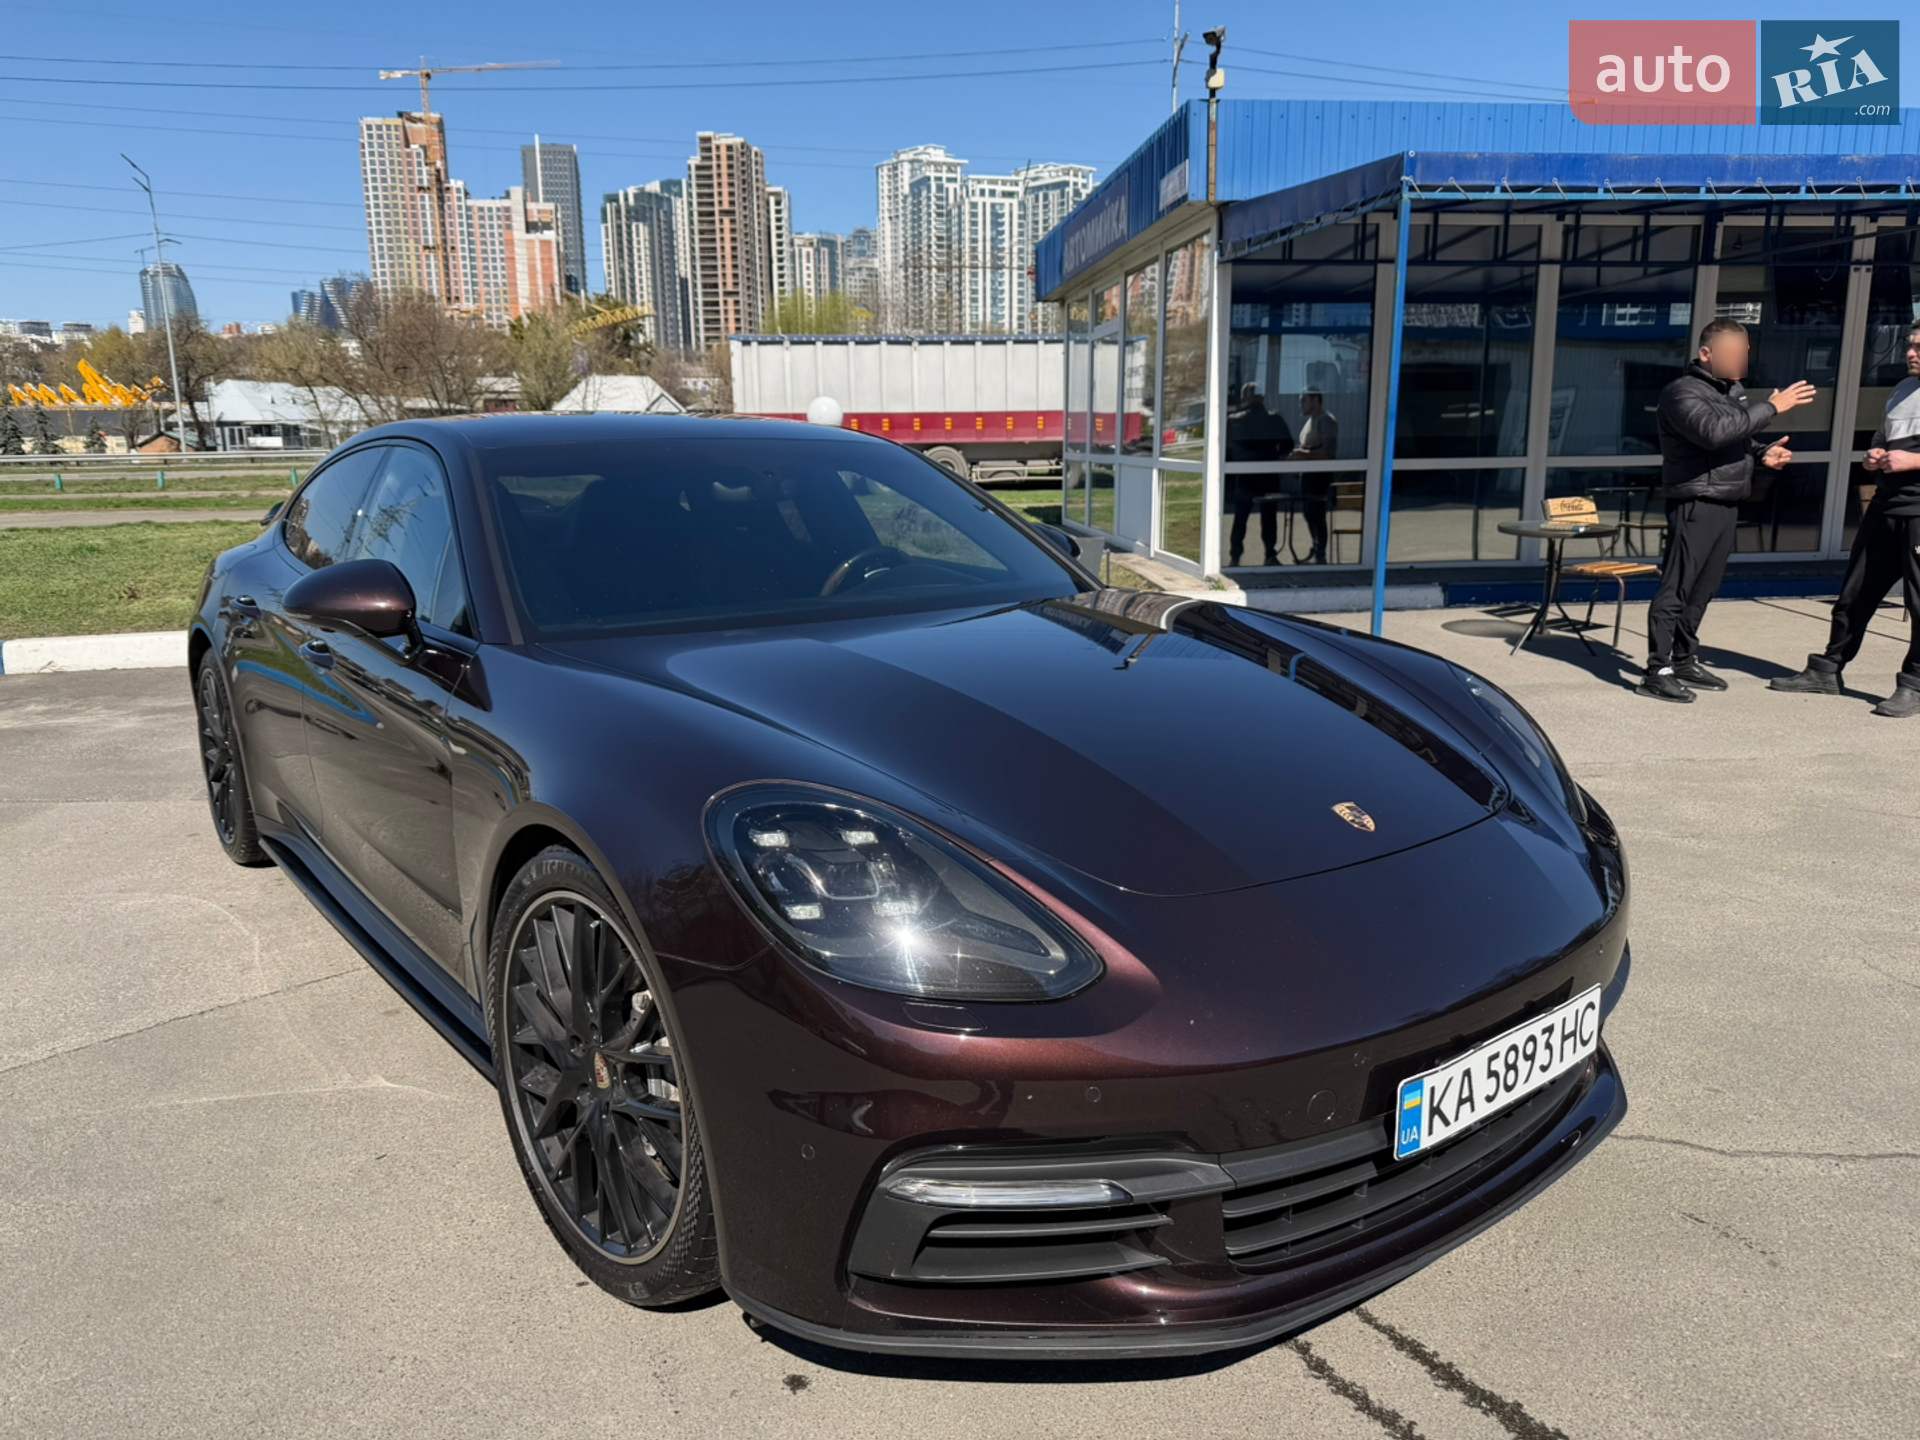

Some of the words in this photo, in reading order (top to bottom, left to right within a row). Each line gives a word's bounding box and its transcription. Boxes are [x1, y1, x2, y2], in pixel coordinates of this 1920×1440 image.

[1062, 195, 1127, 276] АВТОМИЙКА
[1427, 1066, 1475, 1137] KA
[1484, 1022, 1555, 1104] 5893
[1559, 1001, 1596, 1063] HC
[1401, 1128, 1419, 1145] UA
